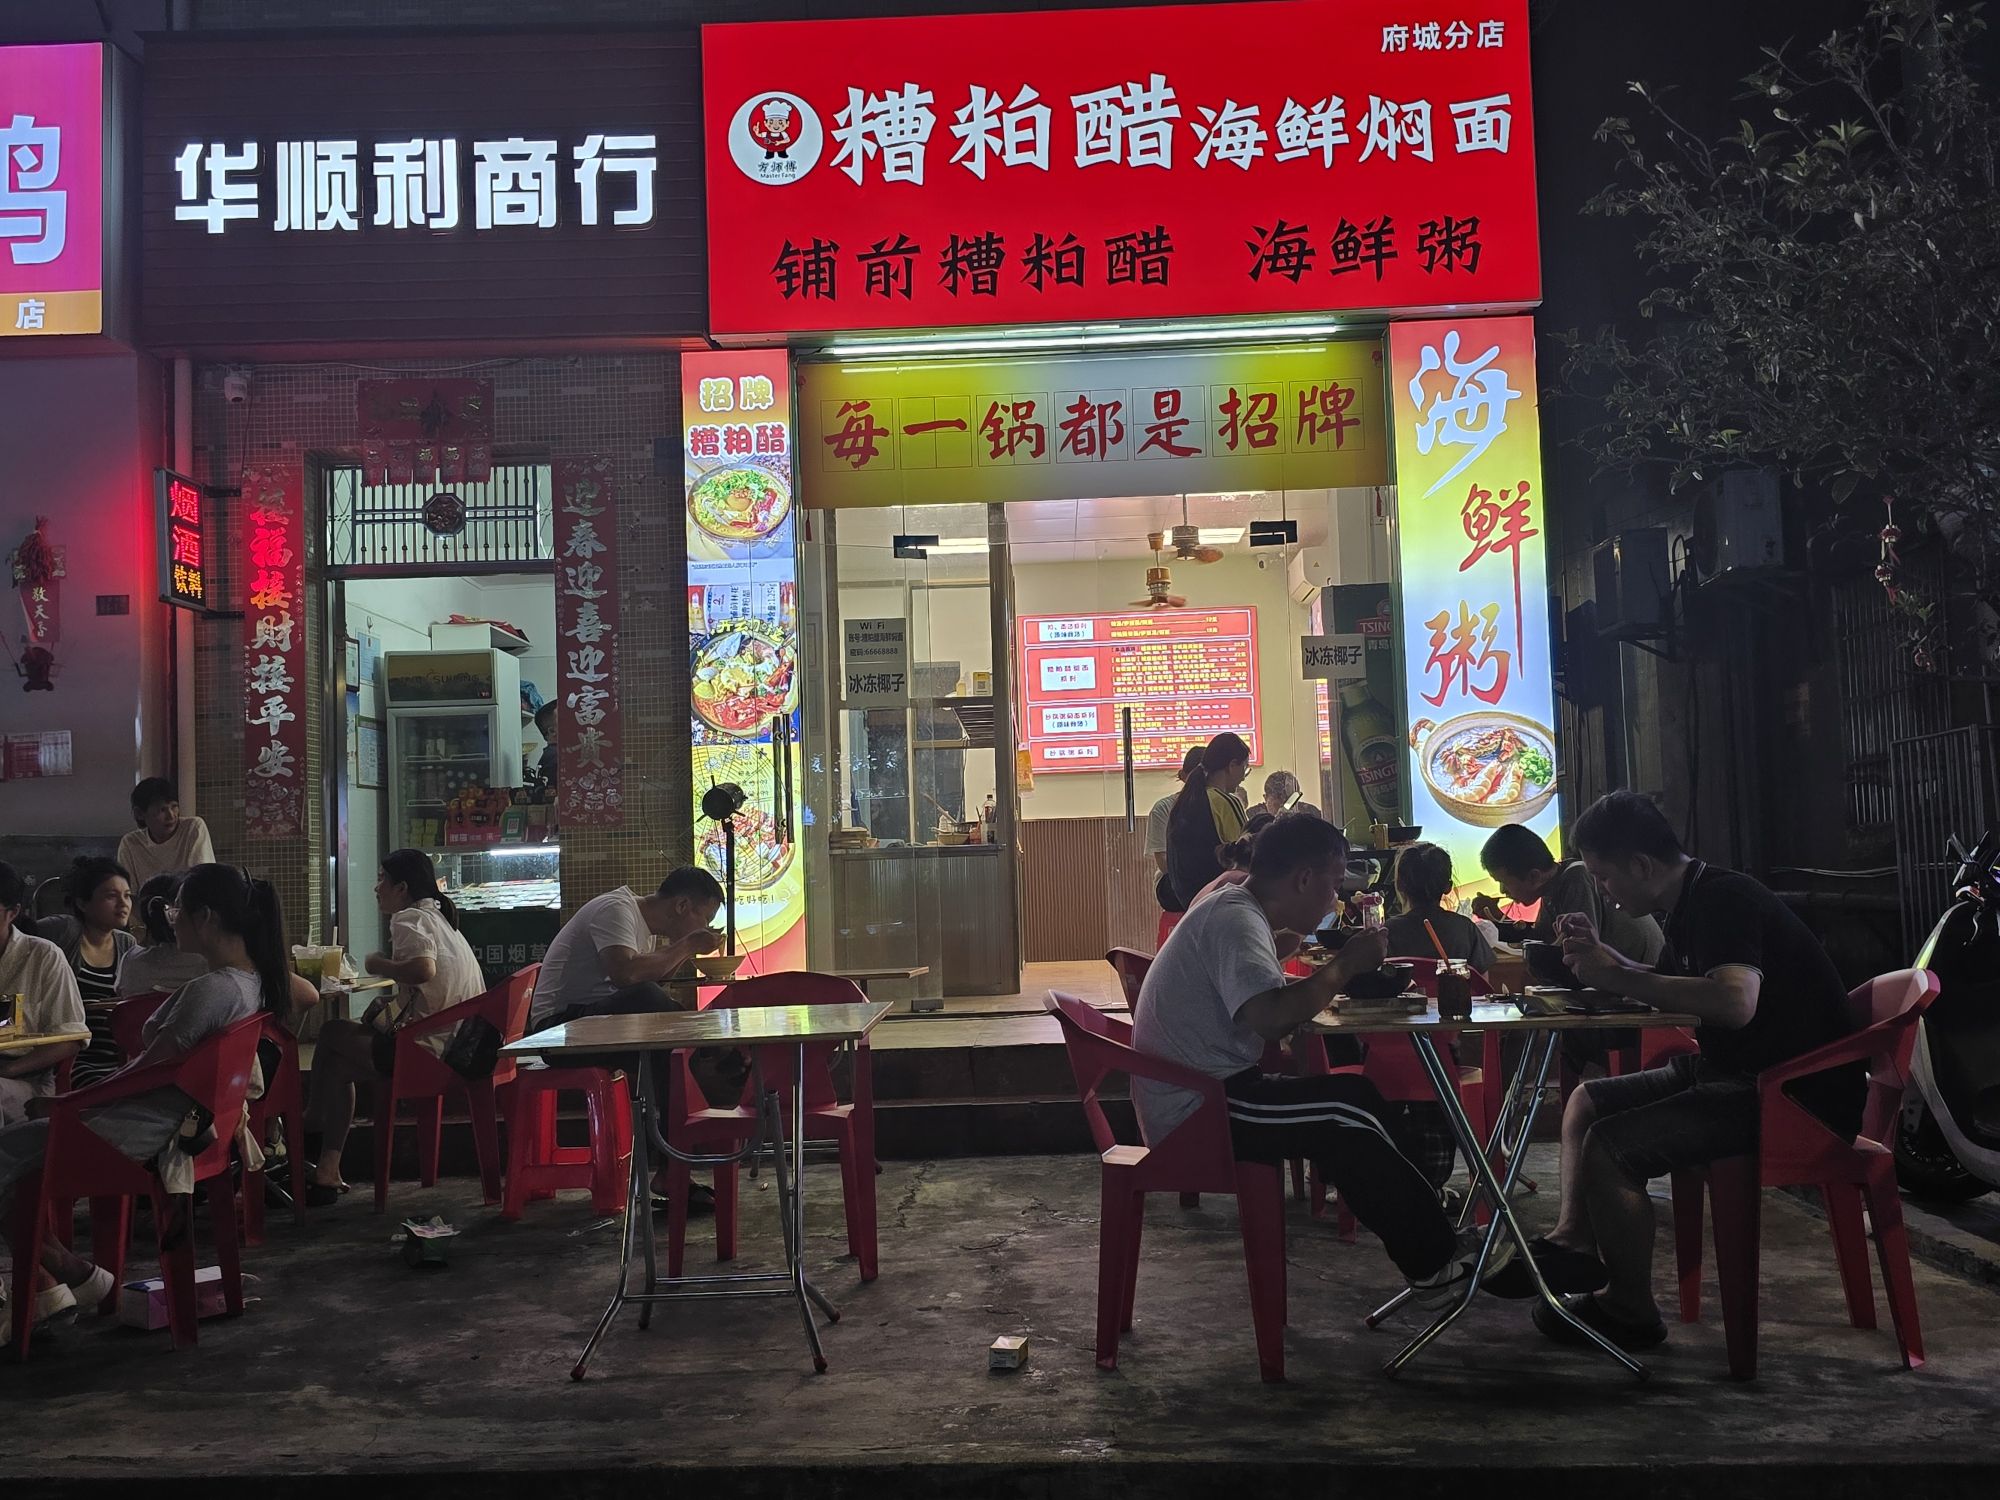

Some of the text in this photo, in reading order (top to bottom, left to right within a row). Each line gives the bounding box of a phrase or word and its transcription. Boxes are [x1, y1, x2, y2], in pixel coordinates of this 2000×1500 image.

[1380, 20, 1505, 54] 府城分店
[830, 73, 1513, 186] 糟粕醋海鲜焖面
[175, 134, 657, 234] 华顺利商行
[770, 215, 1484, 301] 铺前糟粕醋 海鲜粥
[15, 299, 45, 329] 店
[700, 376, 775, 412] 招牌
[687, 422, 788, 458] 糟粕醋
[823, 381, 1361, 469] 每一锅都是招牌
[170, 480, 200, 568] 烟酒
[1409, 330, 1539, 707] 海鲜粥
[860, 621, 885, 630] Wi Fi
[1305, 645, 1362, 666] 冰冻椰子
[1367, 639, 1391, 651] 青岛
[849, 673, 905, 694] 冰冻椰子
